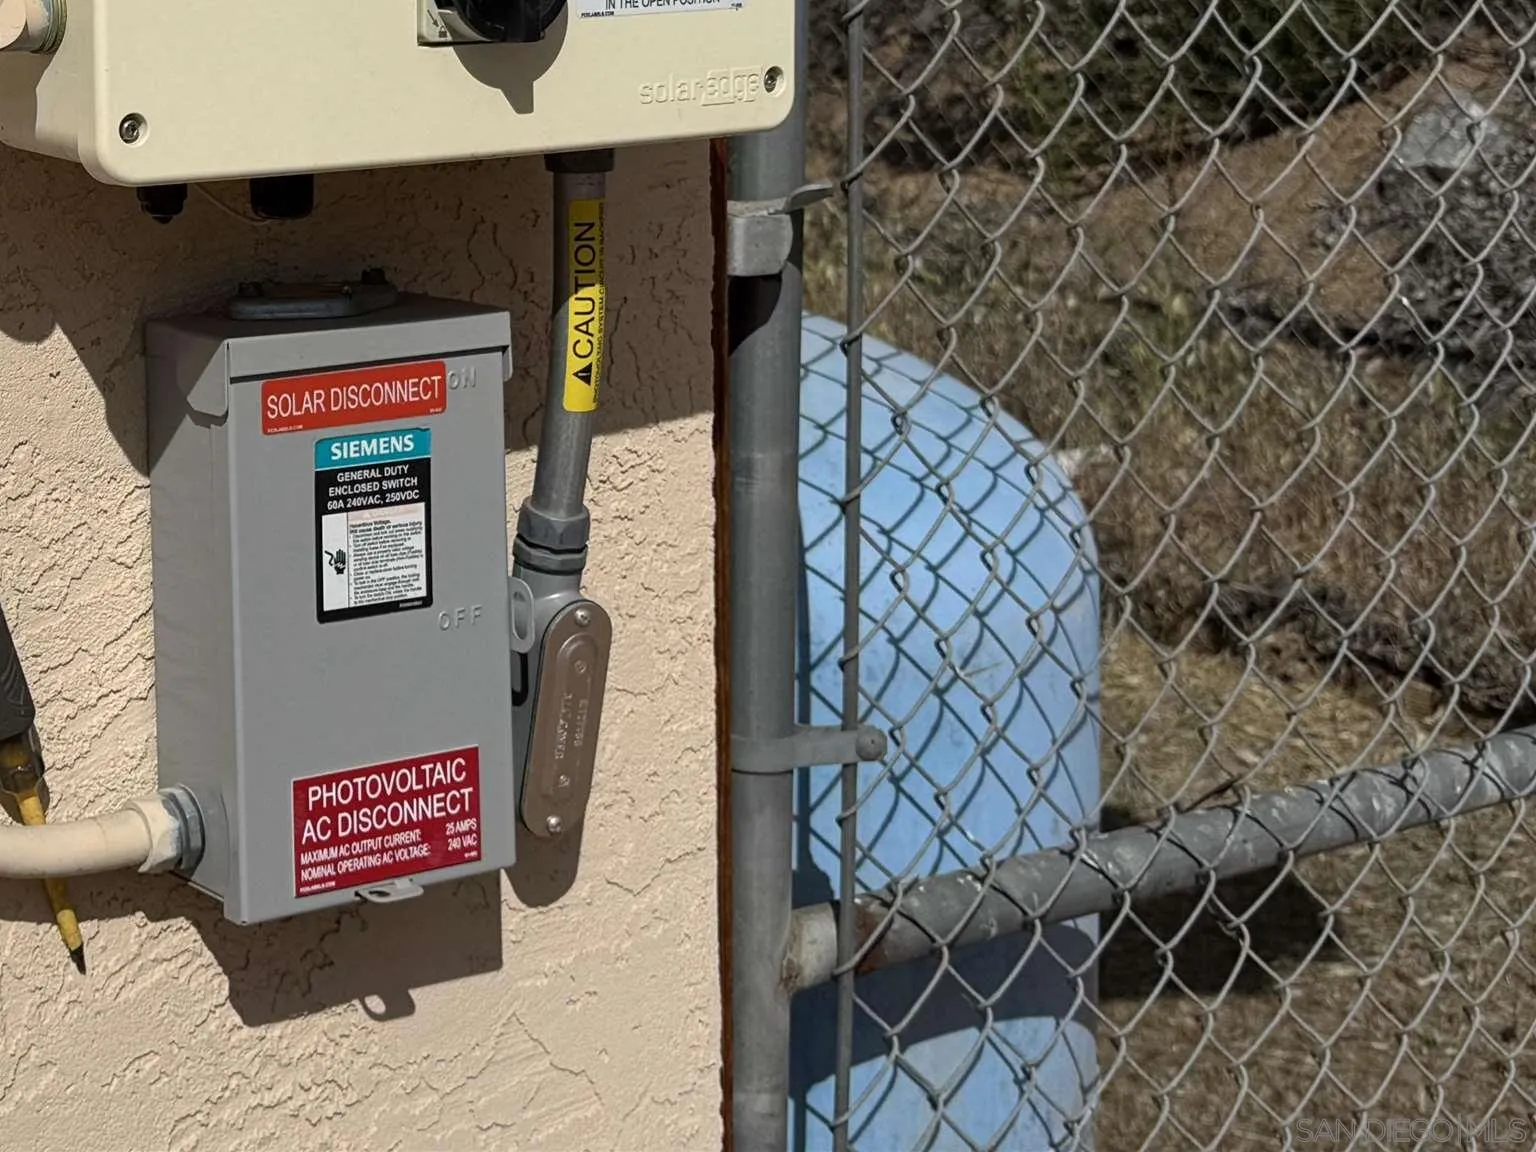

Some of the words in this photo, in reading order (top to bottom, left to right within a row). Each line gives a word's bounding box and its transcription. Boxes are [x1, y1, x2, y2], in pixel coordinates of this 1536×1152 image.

[572, 221, 596, 359] CAUTION
[448, 370, 478, 391] ON
[267, 389, 326, 419] SOLAR
[330, 375, 442, 411] DISCONNECT
[330, 433, 414, 460] SIEMENS
[328, 481, 380, 497] ENCLOSED
[381, 476, 418, 490] SWITCH
[336, 467, 382, 482] GENERAL
[383, 464, 409, 477] DUTY
[385, 489, 420, 503] 250VDC
[438, 604, 484, 632] OFF
[308, 757, 466, 811] PHOTOVOLTAIC
[301, 815, 331, 845] AC
[337, 786, 473, 837] DISCONNECT
